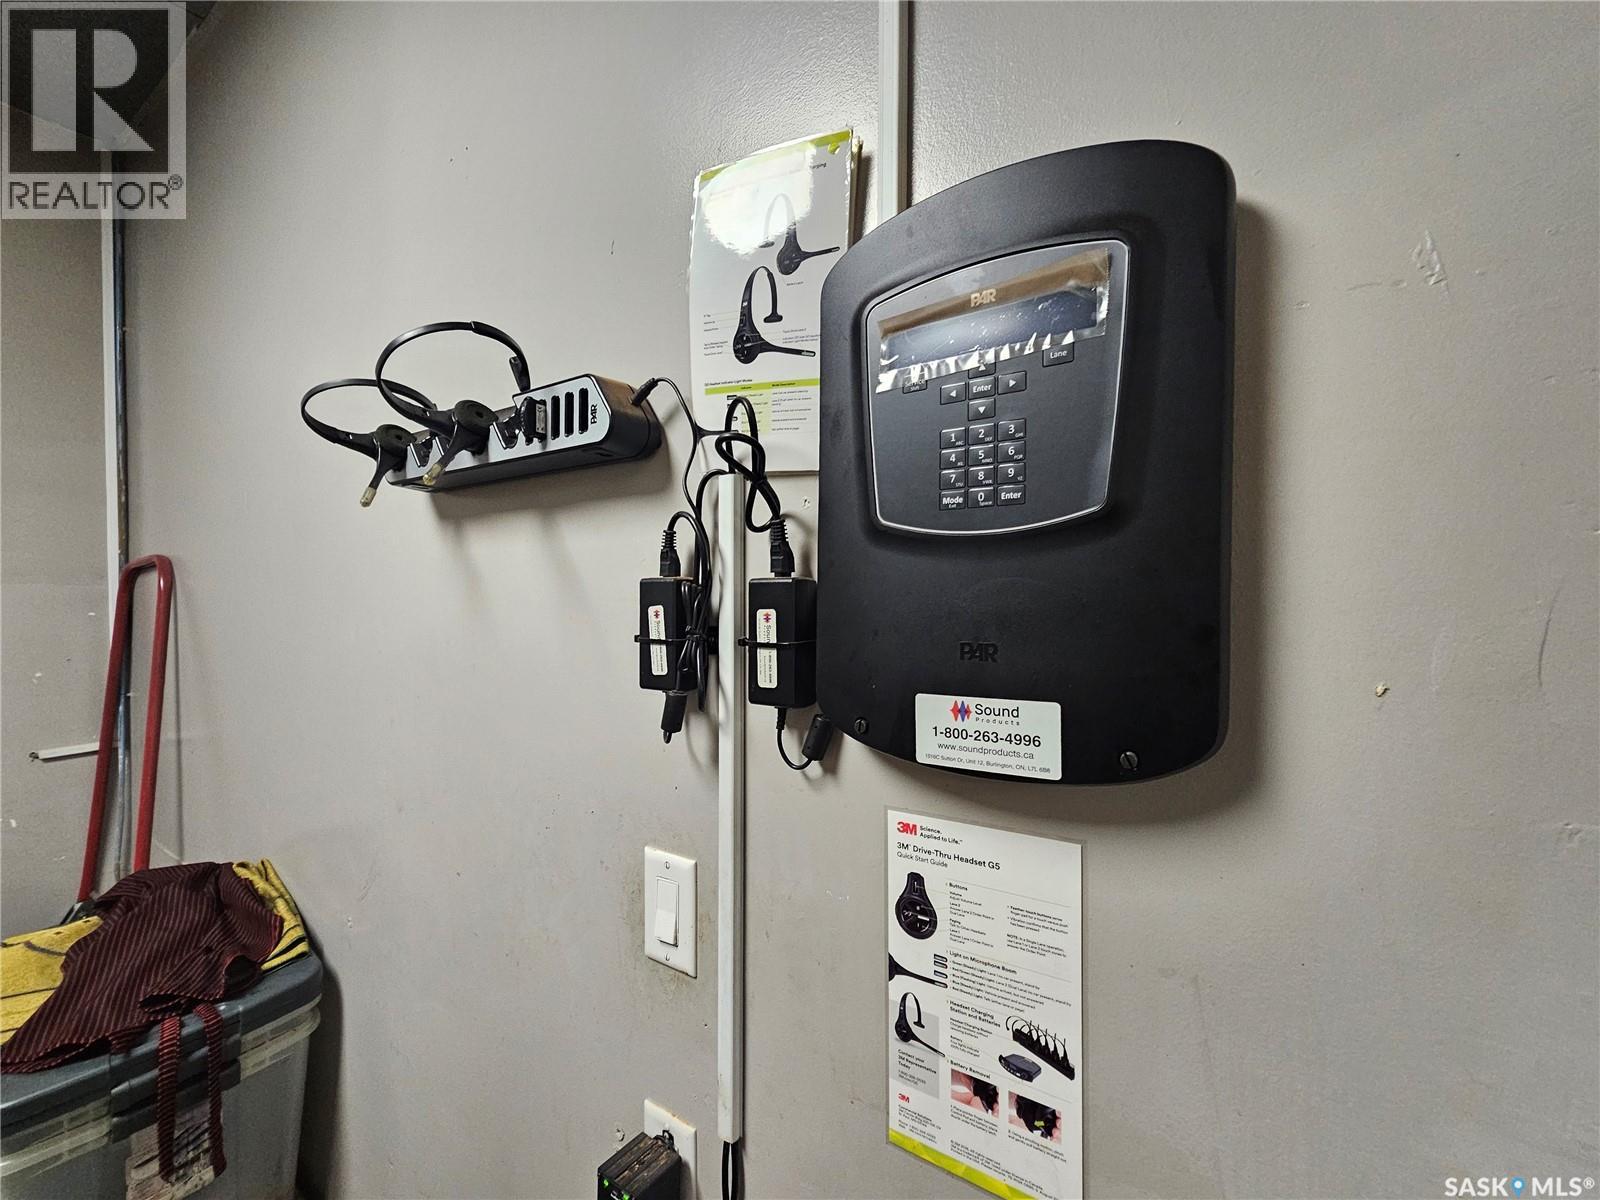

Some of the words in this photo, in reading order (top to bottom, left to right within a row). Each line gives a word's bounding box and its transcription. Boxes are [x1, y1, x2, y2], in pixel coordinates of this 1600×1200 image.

[970, 288, 997, 308] PAR
[1050, 349, 1068, 360] Lane
[972, 384, 992, 393] Enter
[590, 403, 598, 425] PAR
[978, 429, 985, 438] 2
[1008, 424, 1015, 434] 3
[950, 433, 956, 442] 1
[978, 450, 985, 459] 5
[1008, 446, 1015, 455] 6
[950, 453, 956, 462] 4
[978, 471, 985, 480] 8
[1008, 468, 1015, 477] 9
[950, 474, 956, 483] 7
[942, 496, 964, 505] Mode
[978, 492, 985, 502] 0
[1000, 492, 1022, 500] Enter
[959, 640, 999, 663] PAR
[974, 703, 1020, 718] Sound
[975, 717, 1020, 726] Products
[932, 726, 1042, 748] 1-800-263-4996
[937, 743, 1034, 760] www.soundproducts.ca
[896, 821, 918, 836] 3M
[920, 825, 943, 835] Science.
[920, 832, 940, 841] Applied
[896, 852, 914, 860] Quick
[914, 855, 929, 864] Start
[930, 858, 948, 868] Guide
[912, 845, 952, 860] Drive-Thru
[953, 853, 986, 868] Headset
[988, 860, 1001, 870] G5
[949, 950, 962, 958] Light
[970, 956, 1000, 970] Microphone
[1002, 966, 1017, 974] Boom
[950, 1000, 970, 1012] Headset
[969, 1066, 991, 1080] Removal
